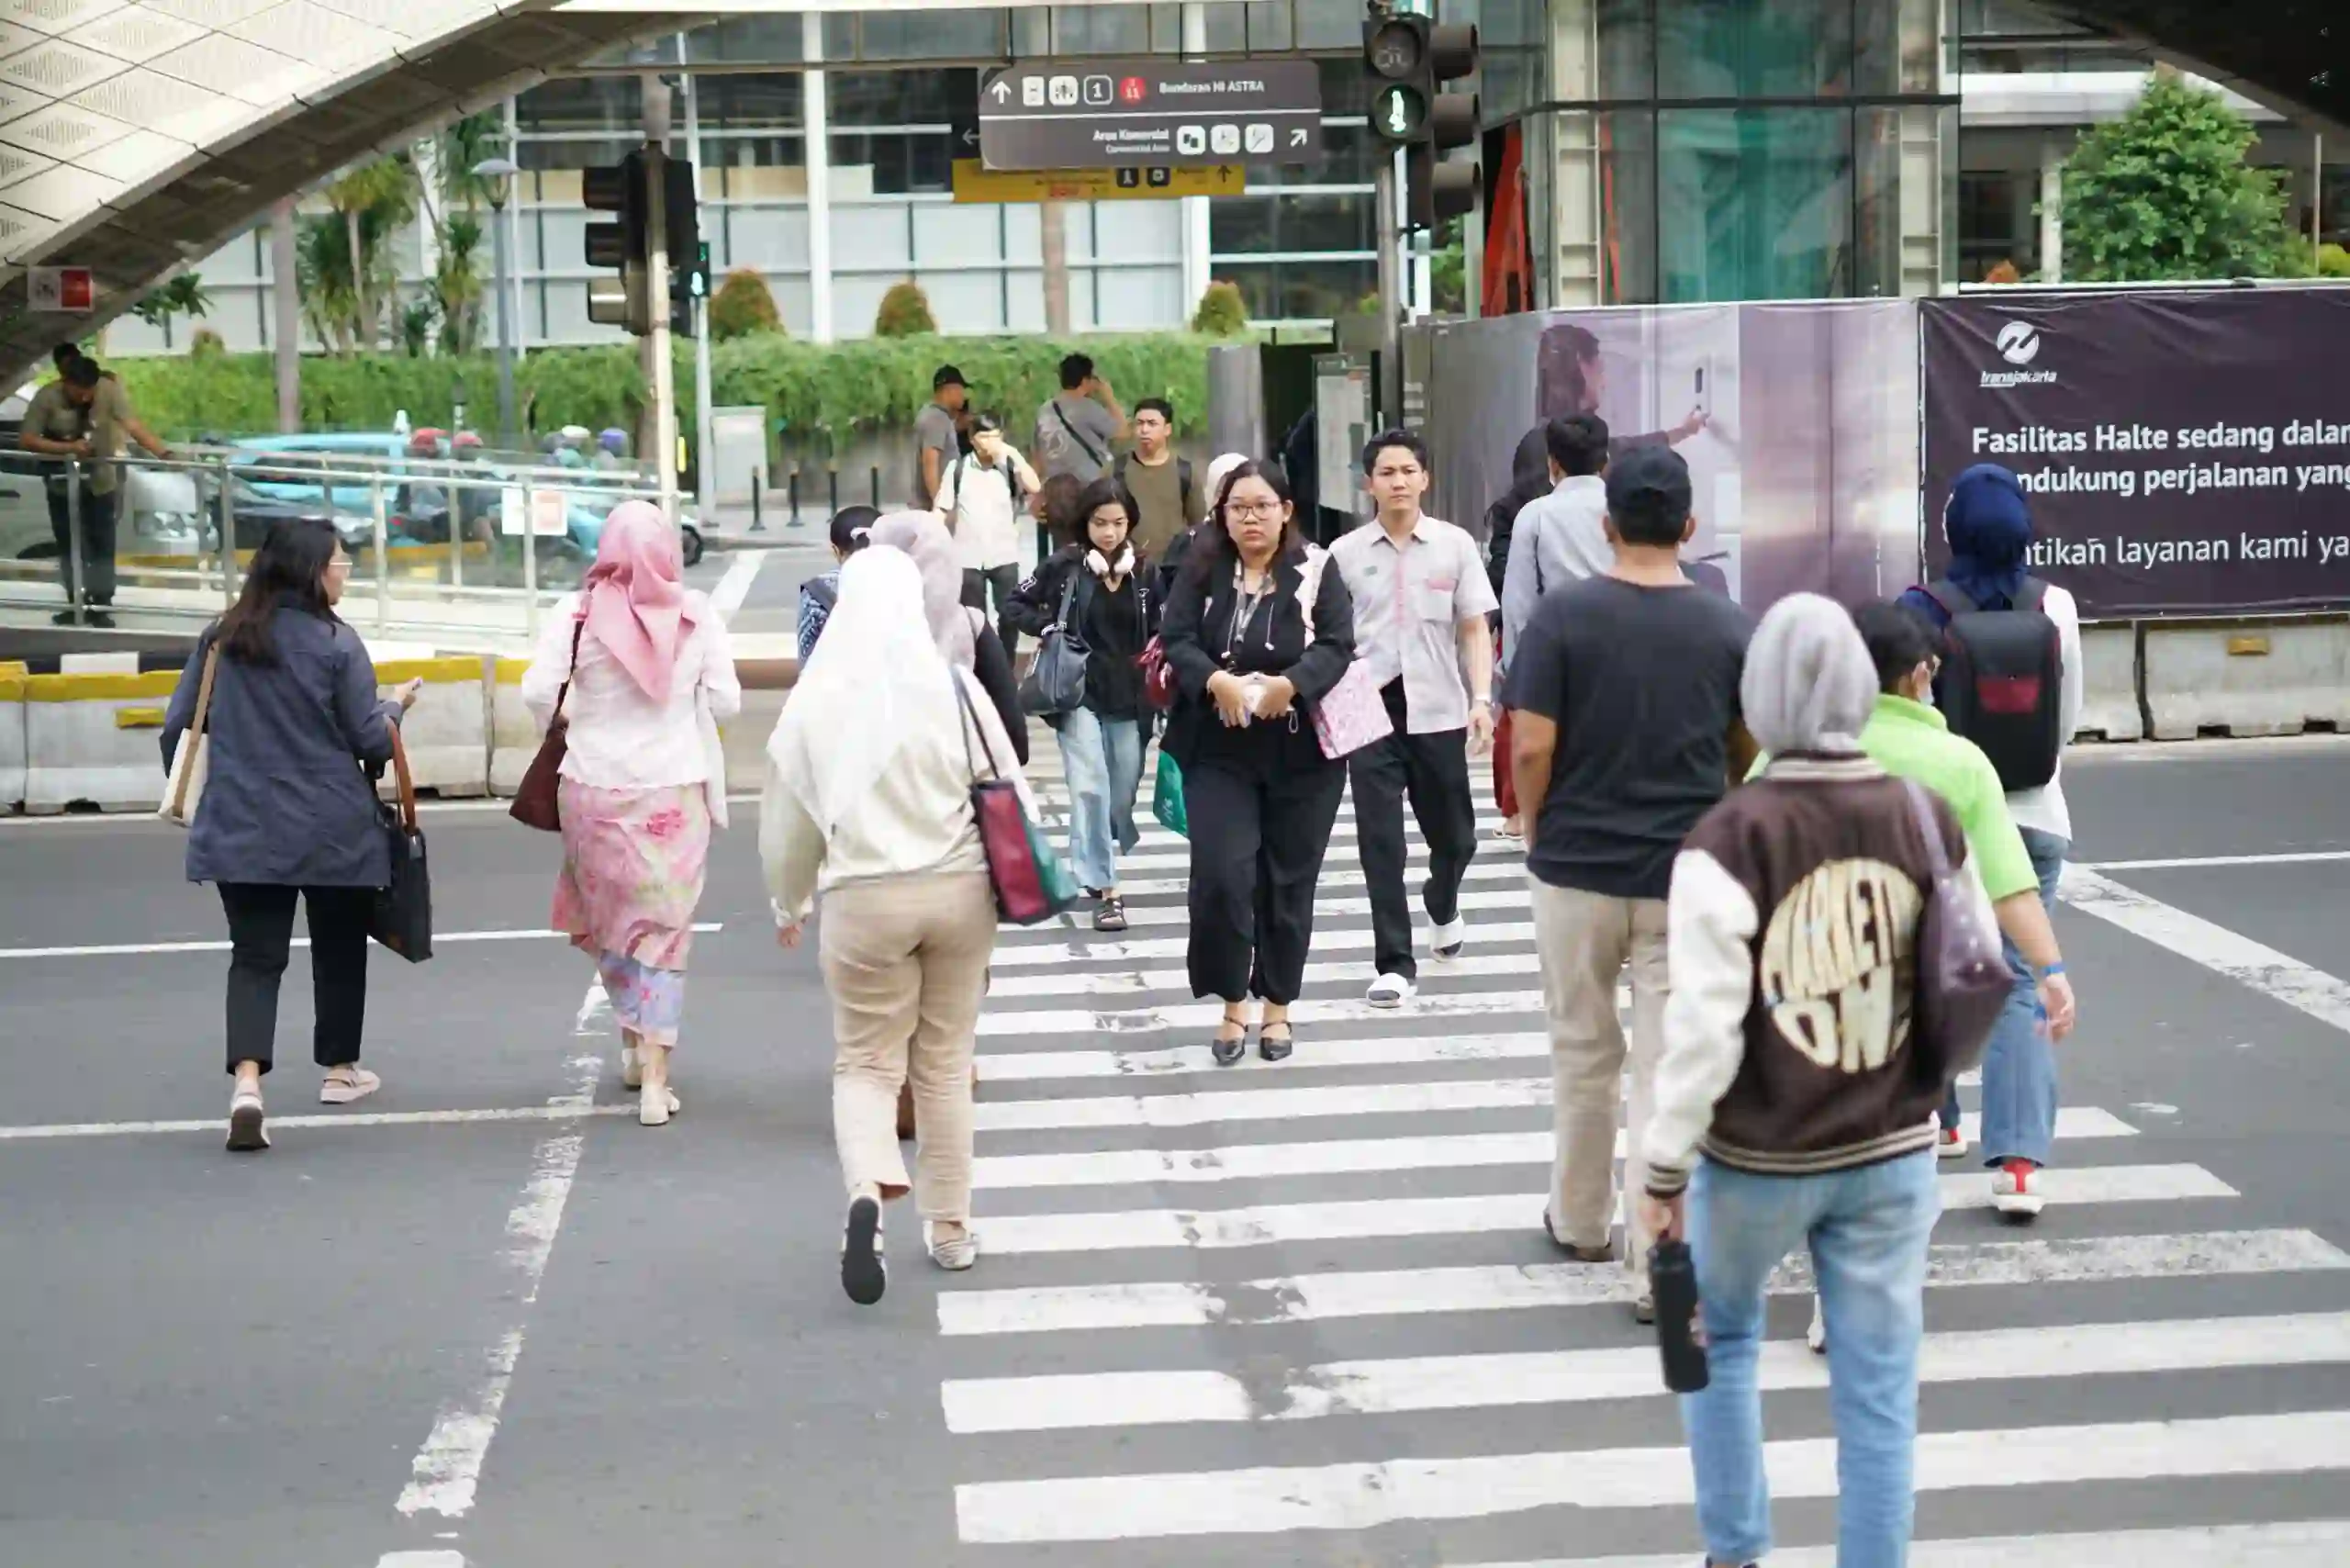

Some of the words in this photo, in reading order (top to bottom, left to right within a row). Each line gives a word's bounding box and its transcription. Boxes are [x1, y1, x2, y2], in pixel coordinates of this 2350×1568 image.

[1227, 80, 1265, 93] ASTRA
[1979, 370, 2057, 386] transjakarta
[1972, 426, 2087, 454] Fasilitas
[2095, 423, 2168, 452] Halte
[2177, 421, 2275, 453] sedang
[2017, 465, 2135, 497] ndukung
[2144, 462, 2288, 497] perjalanan
[2117, 535, 2230, 570] layanan
[2240, 530, 2308, 560] kami
